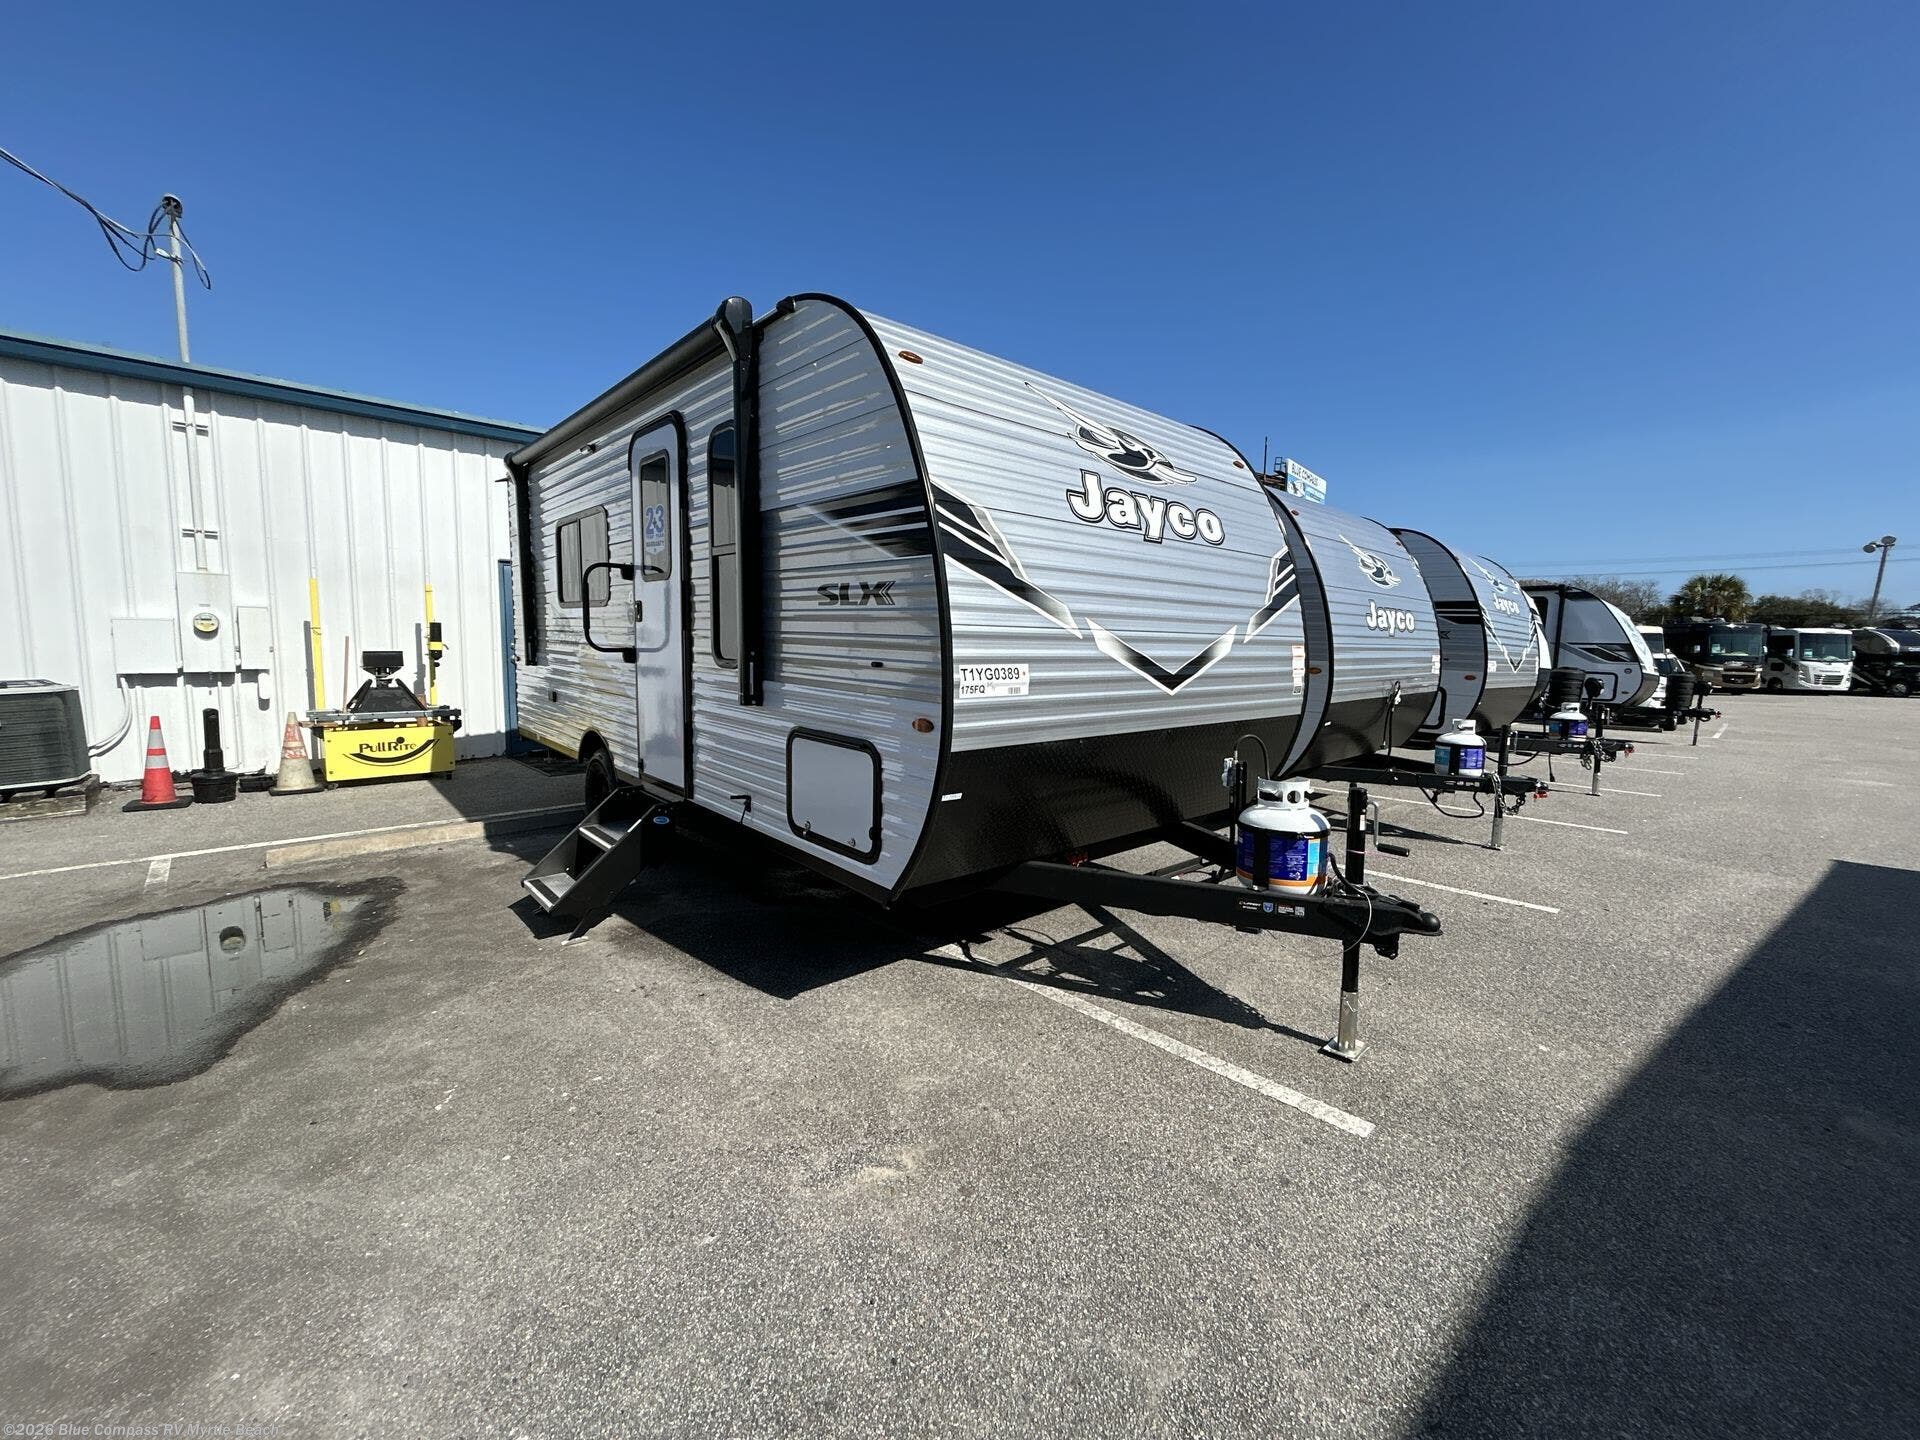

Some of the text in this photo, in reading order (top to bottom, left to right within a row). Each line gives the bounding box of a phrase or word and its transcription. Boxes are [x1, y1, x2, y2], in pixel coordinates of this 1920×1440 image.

[1066, 468, 1225, 545] Jayco
[817, 581, 896, 605] SLX
[1493, 593, 1520, 615] Jayco
[1366, 599, 1415, 637] Jayco
[960, 667, 1020, 681] T1YG0389
[961, 685, 985, 694] 175FQ
